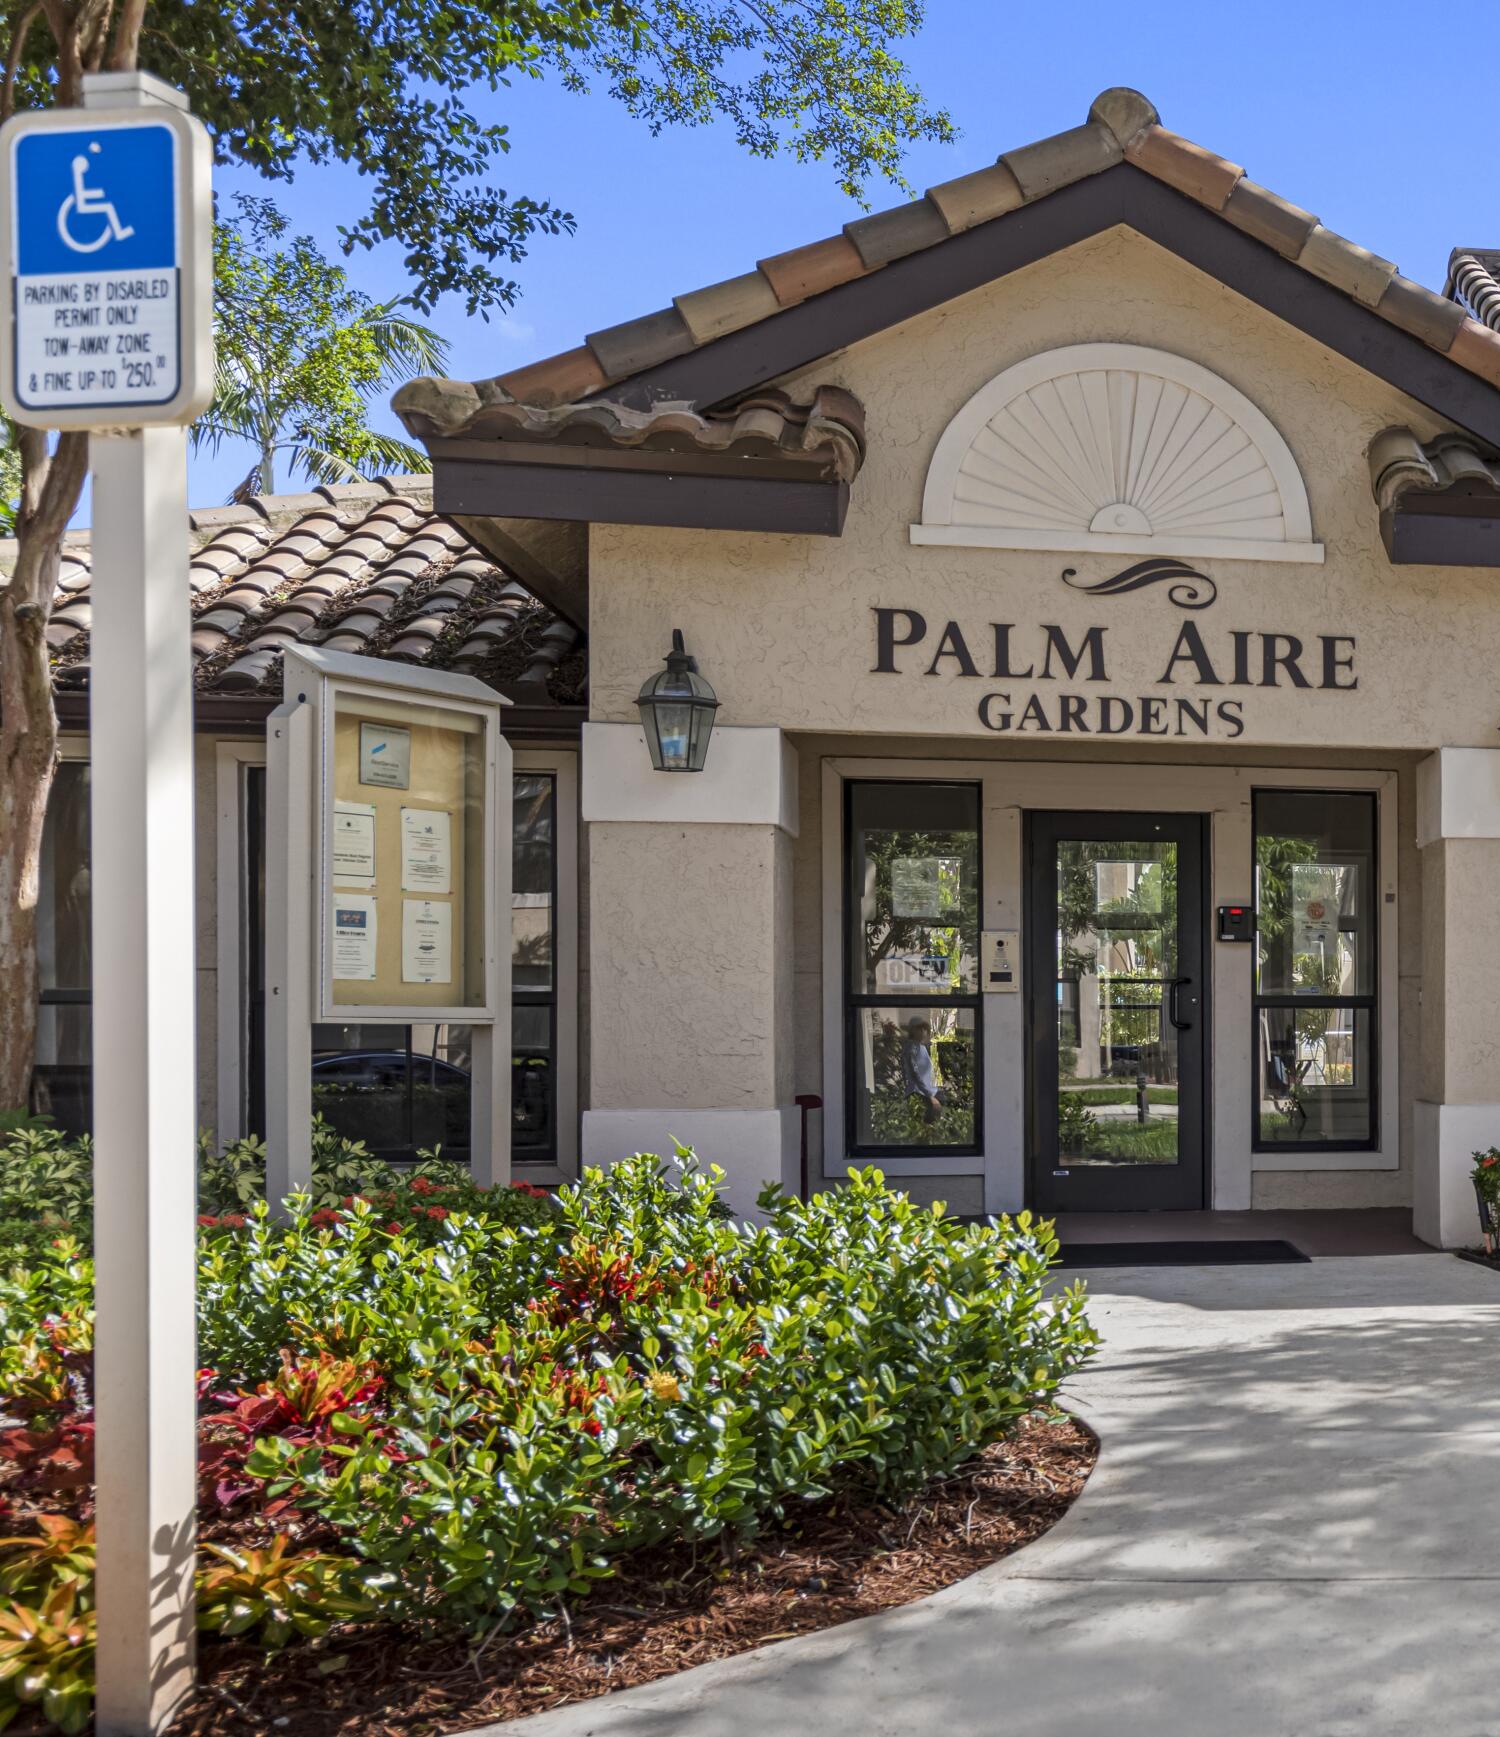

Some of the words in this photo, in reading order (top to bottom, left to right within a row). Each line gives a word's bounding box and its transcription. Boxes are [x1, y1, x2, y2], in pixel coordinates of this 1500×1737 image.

[25, 284, 78, 304] PARKING
[84, 283, 100, 302] BY
[106, 279, 169, 300] DISABLED
[54, 307, 101, 327] PERMIT
[106, 305, 138, 325] ONLY
[44, 336, 110, 356] TOW-AWAY
[116, 333, 151, 353] ZONE
[29, 373, 38, 392] &
[44, 372, 72, 391] FINE
[78, 371, 96, 390] UP
[101, 370, 116, 389] TO
[869, 607, 1112, 682] PALM
[1156, 620, 1359, 690] AIRE
[977, 693, 1245, 737] GARDENS
